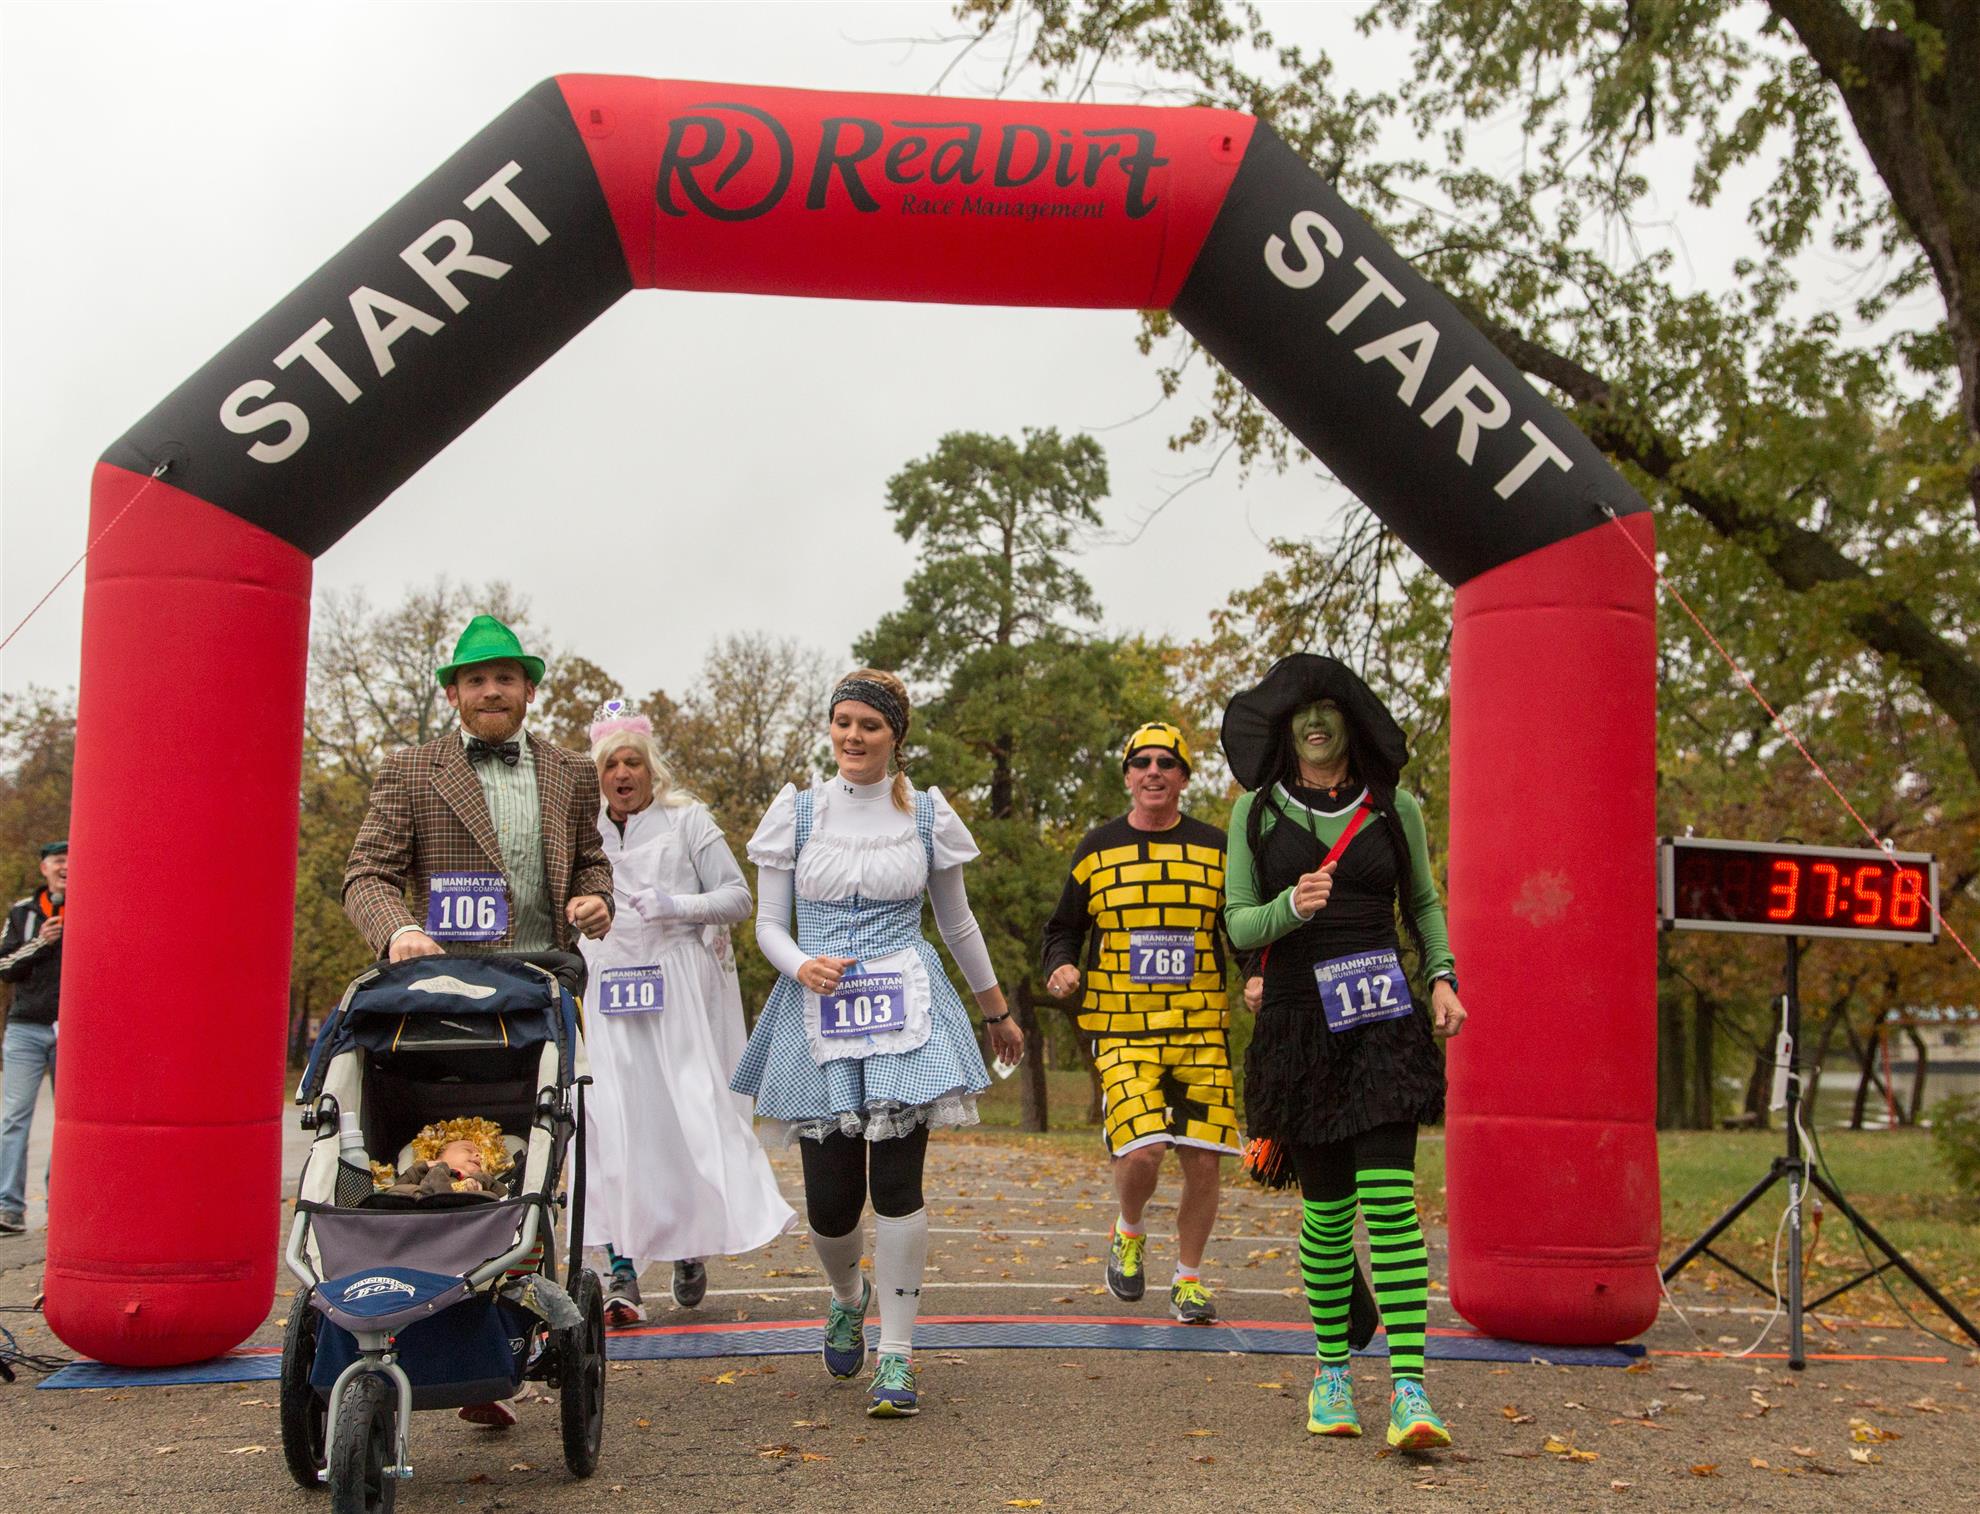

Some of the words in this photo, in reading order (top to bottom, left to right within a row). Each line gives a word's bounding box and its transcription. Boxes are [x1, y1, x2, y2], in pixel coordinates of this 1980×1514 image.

[805, 117, 985, 213] Red
[993, 124, 1169, 221] Dirt
[901, 193, 953, 216] Race
[960, 195, 1106, 221] Management
[219, 160, 552, 464] START
[1264, 210, 1574, 501] START
[442, 877, 507, 886] MANHATTAN
[1767, 861, 1923, 927] 37:58
[439, 895, 497, 930] 106
[1142, 934, 1195, 942] MANHATTAN
[1139, 948, 1186, 976] 768
[1331, 954, 1397, 973] MANHATTAN
[1333, 967, 1367, 980] RUNNING
[1367, 962, 1400, 974] COMPANY
[609, 982, 655, 1008] 110
[835, 977, 902, 990] MANHATTAN
[835, 988, 866, 996] RUNNING
[869, 984, 903, 993] COMPANY
[1335, 974, 1398, 1017] 112
[834, 994, 893, 1028] 103
